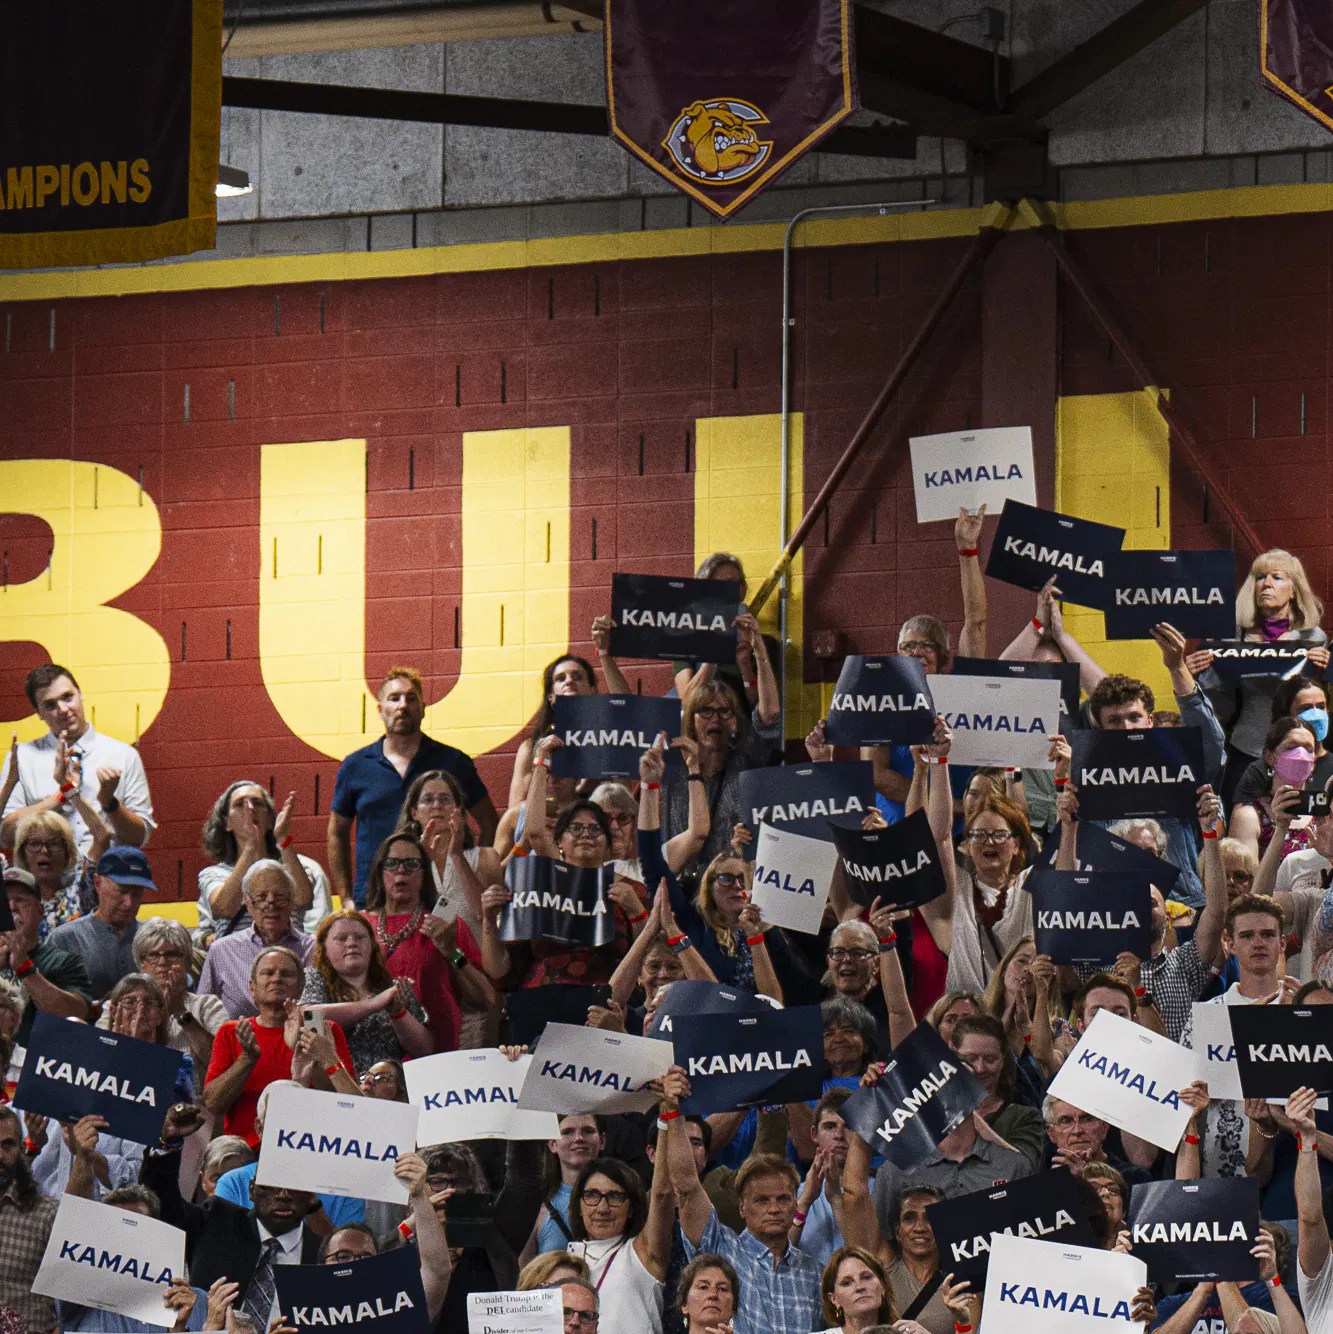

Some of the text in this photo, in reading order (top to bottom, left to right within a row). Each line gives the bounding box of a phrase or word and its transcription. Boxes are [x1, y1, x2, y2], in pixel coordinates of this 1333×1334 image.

[925, 464, 1023, 488] KAMALA
[1004, 536, 1104, 578] KAMALA
[1115, 587, 1223, 606] KAMALA
[622, 608, 726, 632] KAMALA
[1207, 647, 1309, 658] KAMALA
[831, 692, 929, 713] KAMALA
[565, 729, 668, 751] KAMALA
[1081, 765, 1195, 787] KAMALA
[752, 795, 863, 825] KAMALA
[844, 851, 931, 882] KAMALA
[754, 865, 816, 896] MALA
[511, 890, 608, 915] KAMALA
[1037, 911, 1140, 929] KAMALA
[688, 1050, 812, 1075] KAMALA
[36, 1055, 156, 1106] KAMALA
[541, 1061, 643, 1093] KAMAL
[1077, 1049, 1180, 1110] KAMALA
[424, 1086, 520, 1110] KAMAL
[876, 1060, 958, 1140] KAMALA
[277, 1129, 399, 1162] KAMALA
[1133, 1221, 1248, 1244] KAMALA
[60, 1240, 173, 1286] KAMALA
[293, 1290, 411, 1326] KAMALA
[486, 1304, 543, 1316] DEI candidate
[1000, 1282, 1131, 1320] KAMALA
